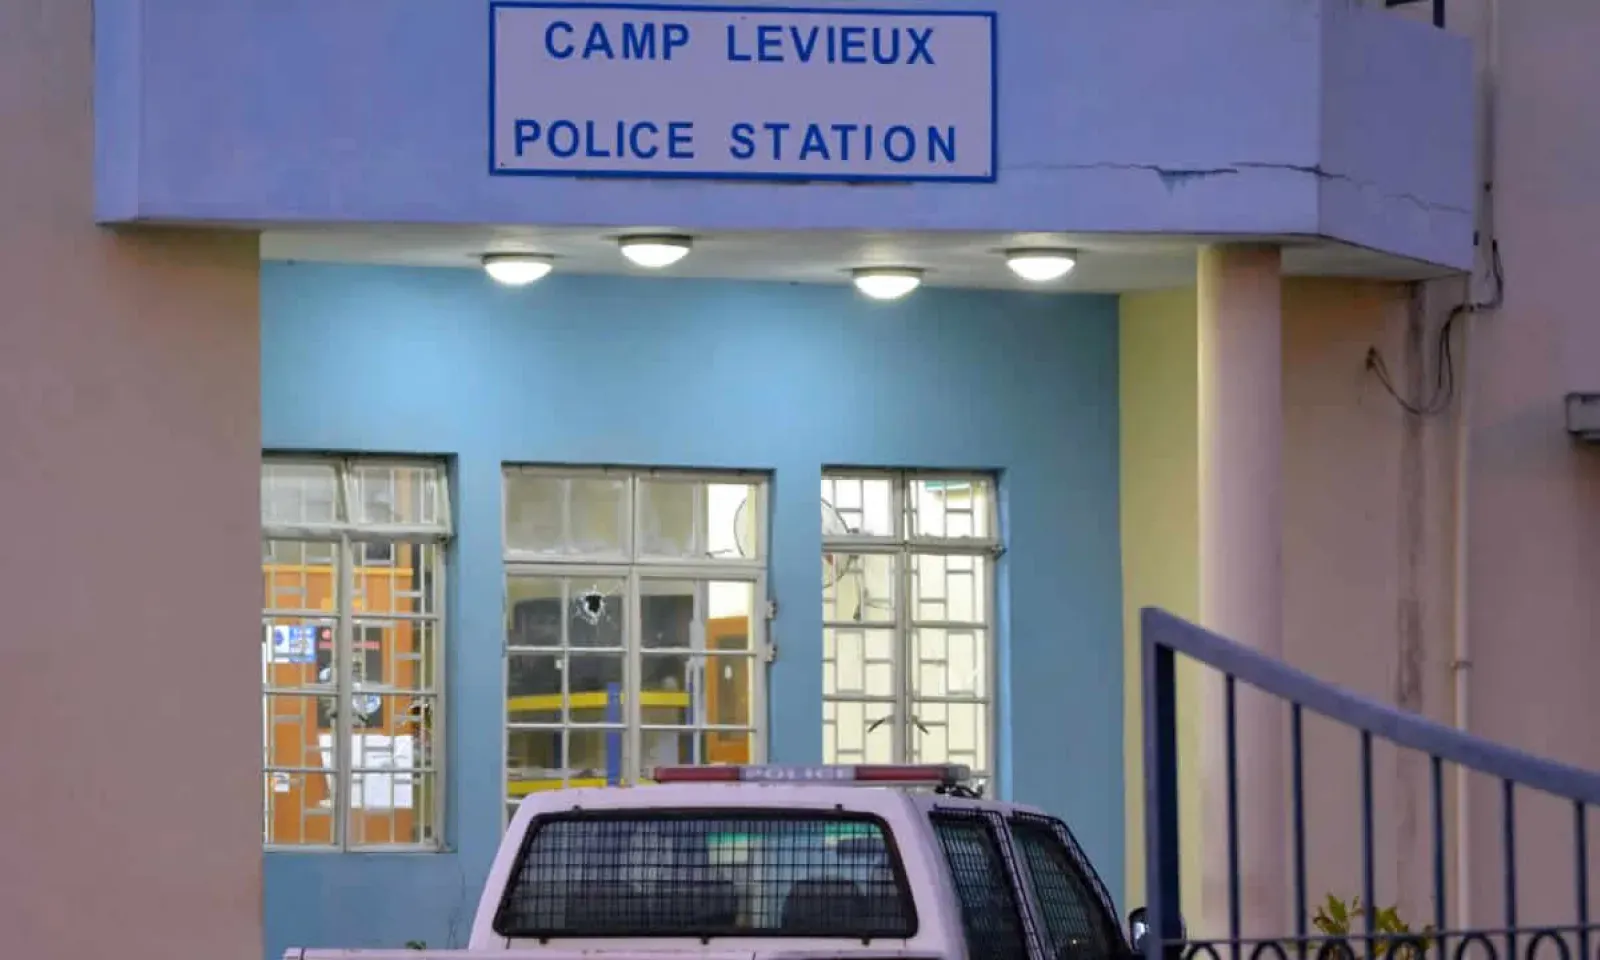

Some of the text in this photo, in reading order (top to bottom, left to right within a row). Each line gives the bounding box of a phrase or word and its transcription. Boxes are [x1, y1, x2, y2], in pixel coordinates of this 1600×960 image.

[545, 21, 936, 65] CAMP LEVIEUX
[514, 119, 957, 164] POLICE STATION
